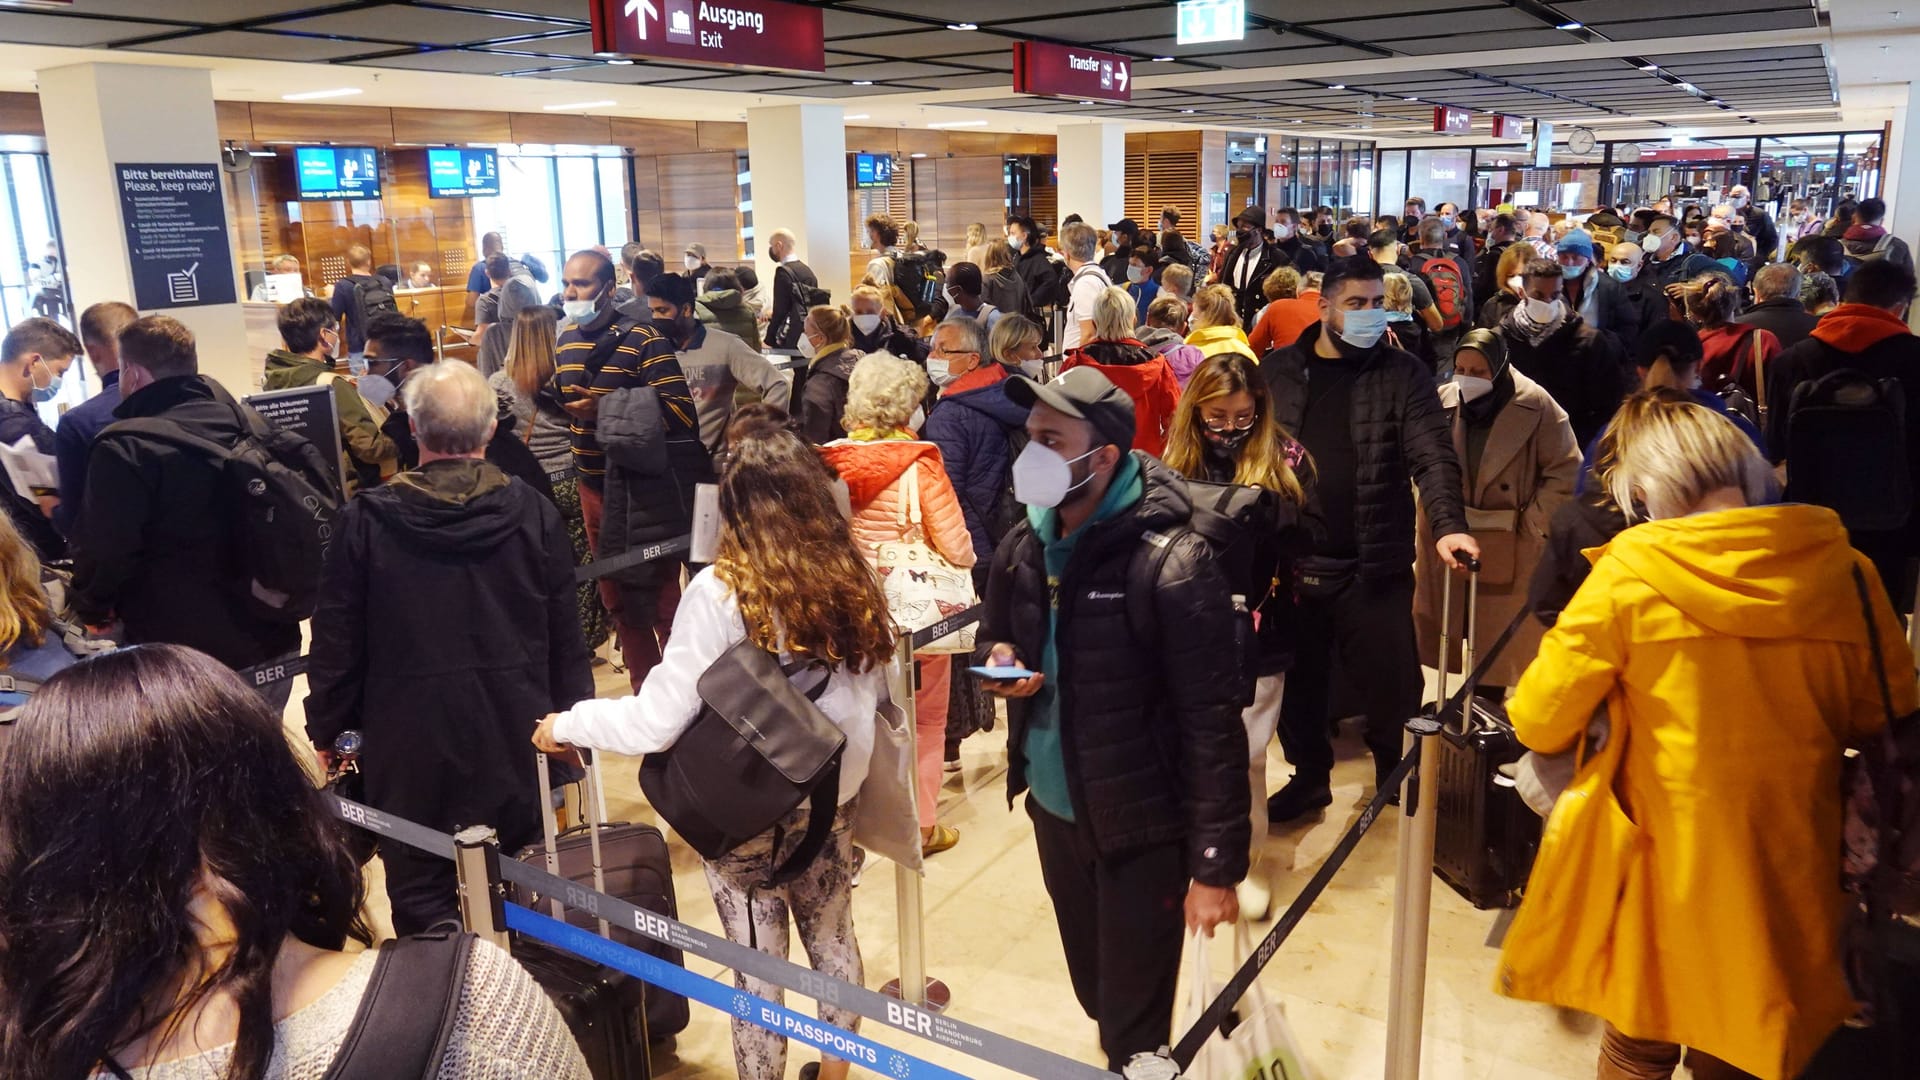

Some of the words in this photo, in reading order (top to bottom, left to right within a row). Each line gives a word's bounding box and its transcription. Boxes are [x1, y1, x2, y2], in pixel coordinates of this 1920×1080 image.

[698, 2, 764, 34] Ausgang
[700, 30, 723, 49] Exit
[1068, 54, 1100, 72] Transfer
[122, 169, 149, 180] Bitte
[150, 169, 214, 180] bereithalten!
[124, 181, 159, 192] Please,
[160, 181, 184, 193] keep
[186, 181, 216, 193] ready!
[550, 471, 566, 482] BER
[642, 545, 661, 560] BER
[932, 620, 949, 639] BER
[255, 665, 286, 686] BER
[340, 800, 366, 825] BER
[1359, 805, 1374, 835] BER
[633, 910, 670, 941] BER
[670, 923, 688, 934] BERLIN
[1257, 930, 1277, 969] BER
[887, 1001, 933, 1036] BER
[934, 1017, 958, 1030] BERLIN
[761, 1007, 781, 1026] EU
[785, 1016, 877, 1064] PASSPORTS
[935, 1024, 983, 1047] BRANDENBURG
[935, 1033, 963, 1047] AIRPORT
